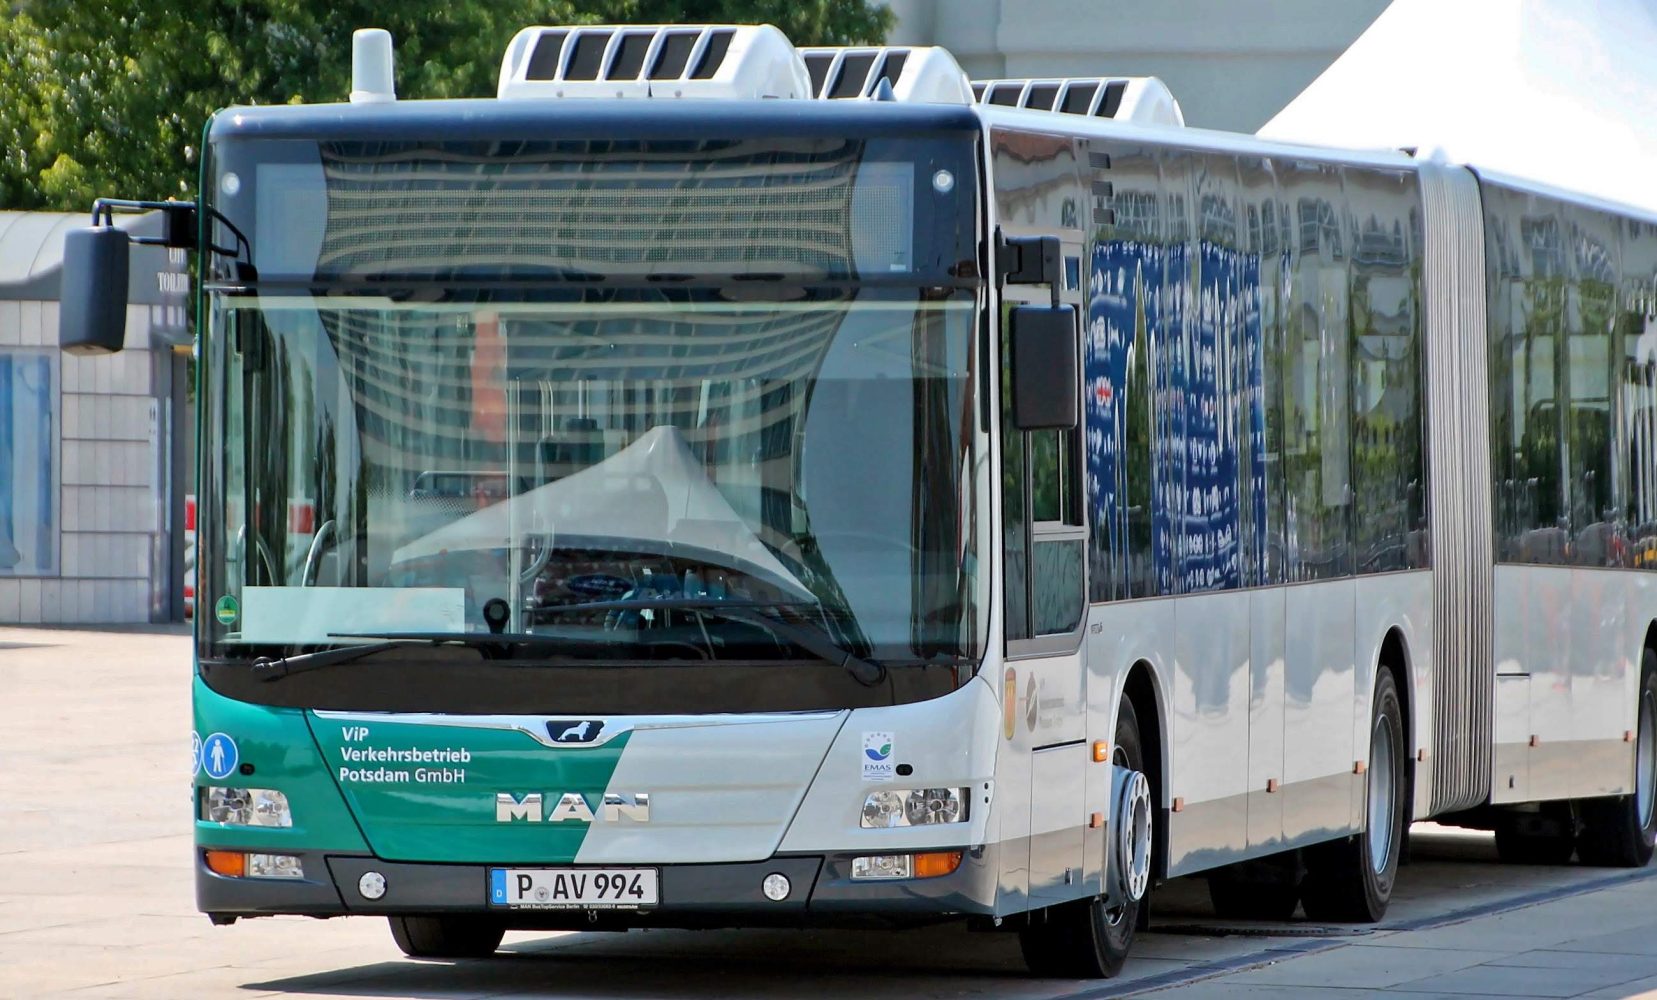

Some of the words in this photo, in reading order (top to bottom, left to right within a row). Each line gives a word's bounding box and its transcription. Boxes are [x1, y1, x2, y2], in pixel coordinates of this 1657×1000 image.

[341, 726, 369, 742] ViP
[340, 746, 471, 763] Verkehrsbetrieb
[339, 766, 410, 783] Potsdam
[414, 767, 465, 784] GmbH
[496, 792, 650, 823] MAN
[496, 890, 502, 898] D
[516, 874, 533, 900] P
[552, 873, 587, 900] AV
[594, 873, 644, 900] 994
